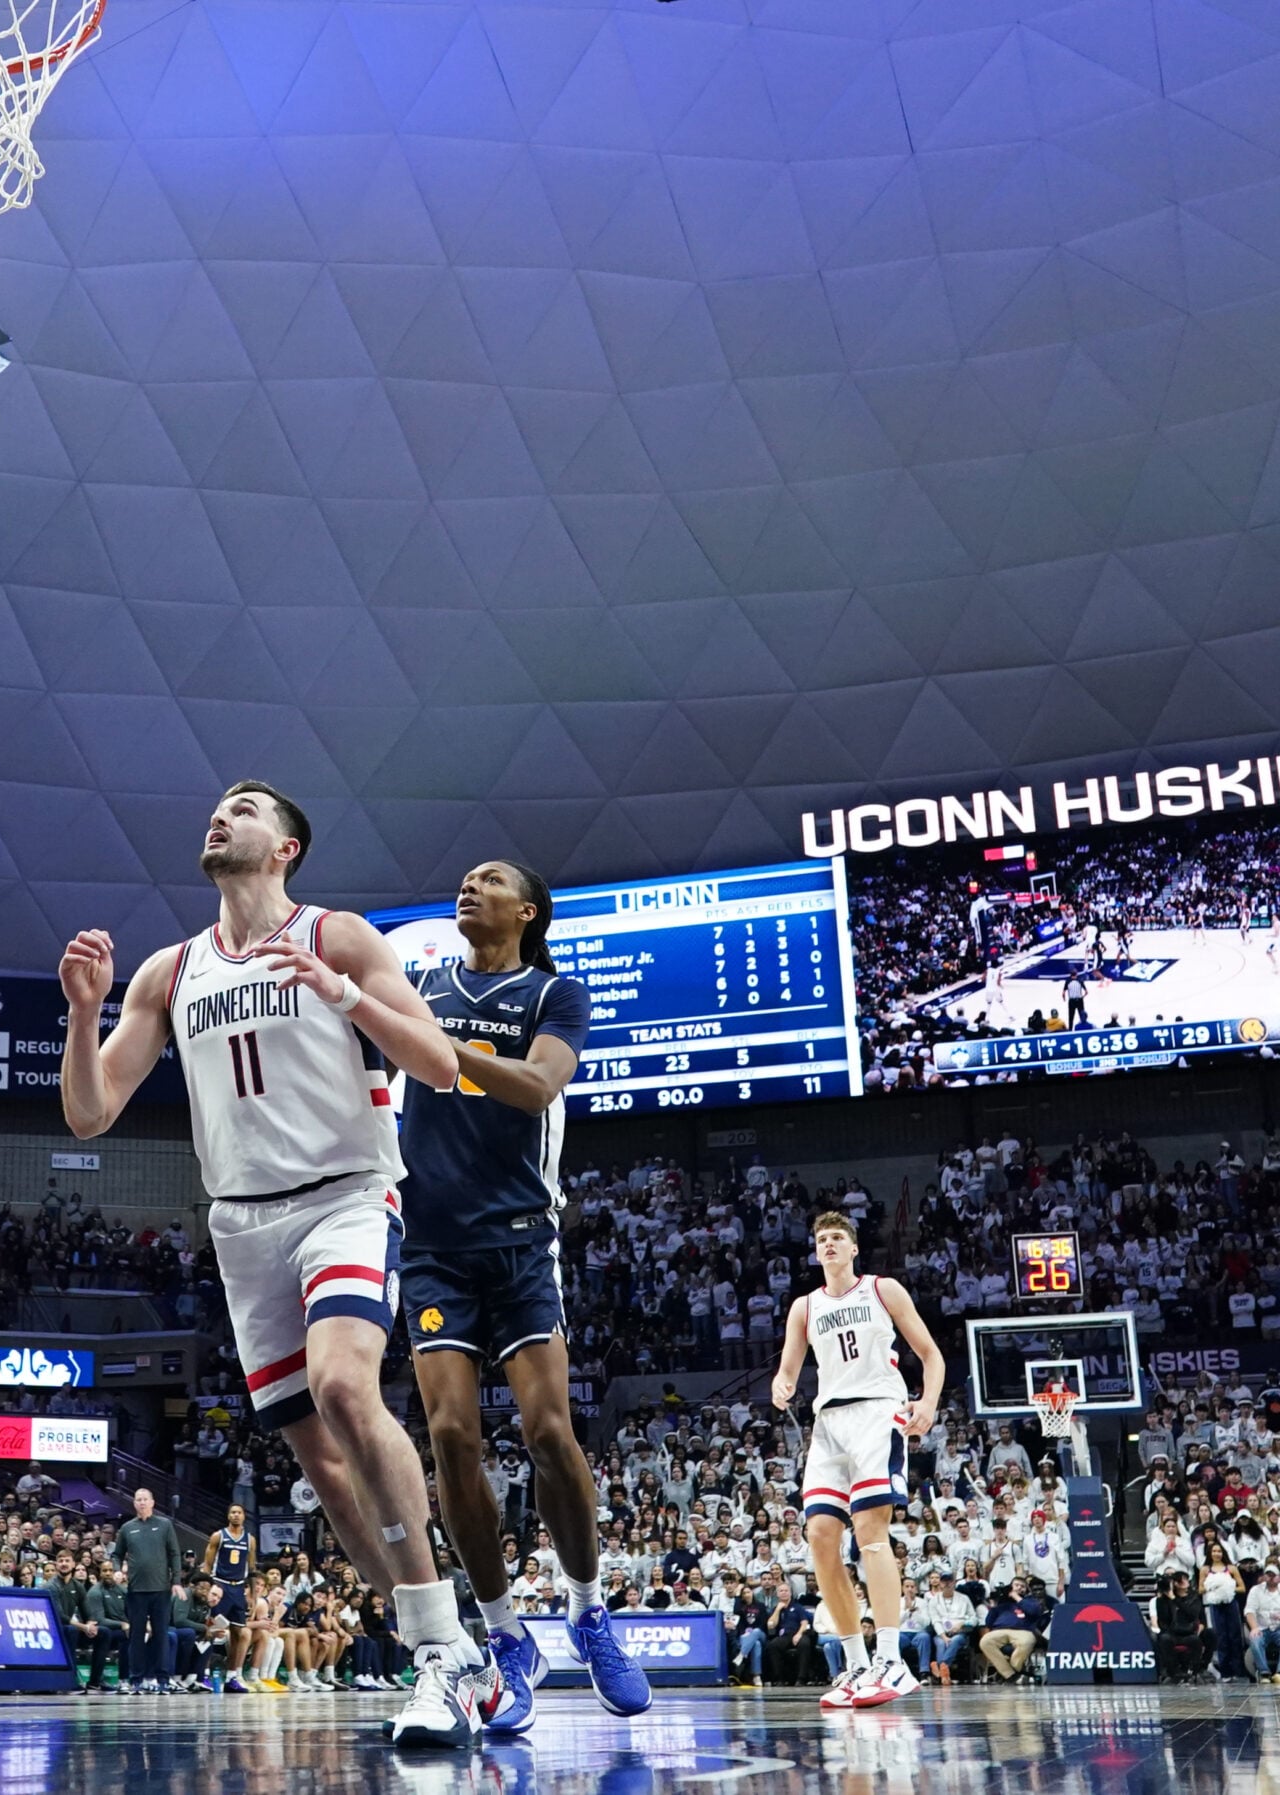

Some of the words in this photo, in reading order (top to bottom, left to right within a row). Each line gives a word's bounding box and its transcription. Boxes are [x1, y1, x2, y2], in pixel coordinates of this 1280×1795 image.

[801, 787, 1037, 858] UCONN
[1052, 756, 1280, 829] HUSKI
[615, 881, 720, 914] UCONN
[706, 908, 728, 919] PTS
[736, 904, 760, 915] AST
[767, 901, 792, 912] REB
[548, 942, 574, 957] olo
[576, 939, 604, 954] Ball
[713, 926, 724, 939] 7
[745, 923, 753, 936] 1
[776, 920, 787, 933] 3
[810, 916, 818, 929] 1
[578, 954, 634, 970] Demary
[636, 951, 655, 965] Jr.
[714, 944, 725, 956] 6
[746, 940, 756, 953] 2
[777, 937, 788, 950] 3
[811, 934, 819, 946] 1
[587, 969, 643, 986] Stewart
[716, 961, 726, 974] 7
[747, 957, 757, 971] 2
[779, 954, 789, 967] 3
[810, 951, 822, 963] 0
[590, 987, 639, 1003] araban
[716, 977, 727, 990] 6
[747, 974, 759, 988] 0
[780, 971, 790, 984] 5
[814, 968, 821, 980] 1
[718, 995, 728, 1008] 7
[748, 992, 760, 1005] 0
[780, 988, 792, 1001] 4
[813, 985, 825, 998] 0
[187, 981, 302, 1040] CONNECTICUT
[435, 1017, 467, 1030] AST
[469, 1019, 522, 1036] TEXAS
[630, 1028, 673, 1043] TEAM
[676, 1022, 722, 1039] STATS
[15, 1039, 63, 1056] REGU
[1003, 1042, 1032, 1060] 43
[1074, 1033, 1139, 1055] 16:36
[1181, 1026, 1211, 1045] 29
[1047, 1048, 1053, 1057] 1
[1160, 1038, 1166, 1047] 1
[228, 1030, 265, 1099] 11
[665, 1055, 690, 1072] 23
[737, 1049, 749, 1065] 5
[805, 1043, 815, 1059] 1
[1049, 1060, 1083, 1072] BONUS
[1133, 1054, 1168, 1065] BONUS
[590, 1094, 633, 1112] 25.0
[657, 1087, 704, 1106] 90.0
[738, 1083, 752, 1099] 3
[803, 1077, 822, 1093] 11
[727, 1132, 755, 1145] 202
[79, 1156, 95, 1168] 14
[1027, 1239, 1073, 1259] 16:36
[1028, 1258, 1070, 1291] 26
[816, 1305, 872, 1336] CONNECTICUT
[837, 1329, 860, 1363] 12
[38, 1431, 101, 1444] PROBLEM
[38, 1443, 101, 1454] GAMBLING
[5, 1609, 50, 1630] UCONN
[626, 1626, 691, 1642] UCONN
[1046, 1651, 1156, 1670] TRAVELERS
